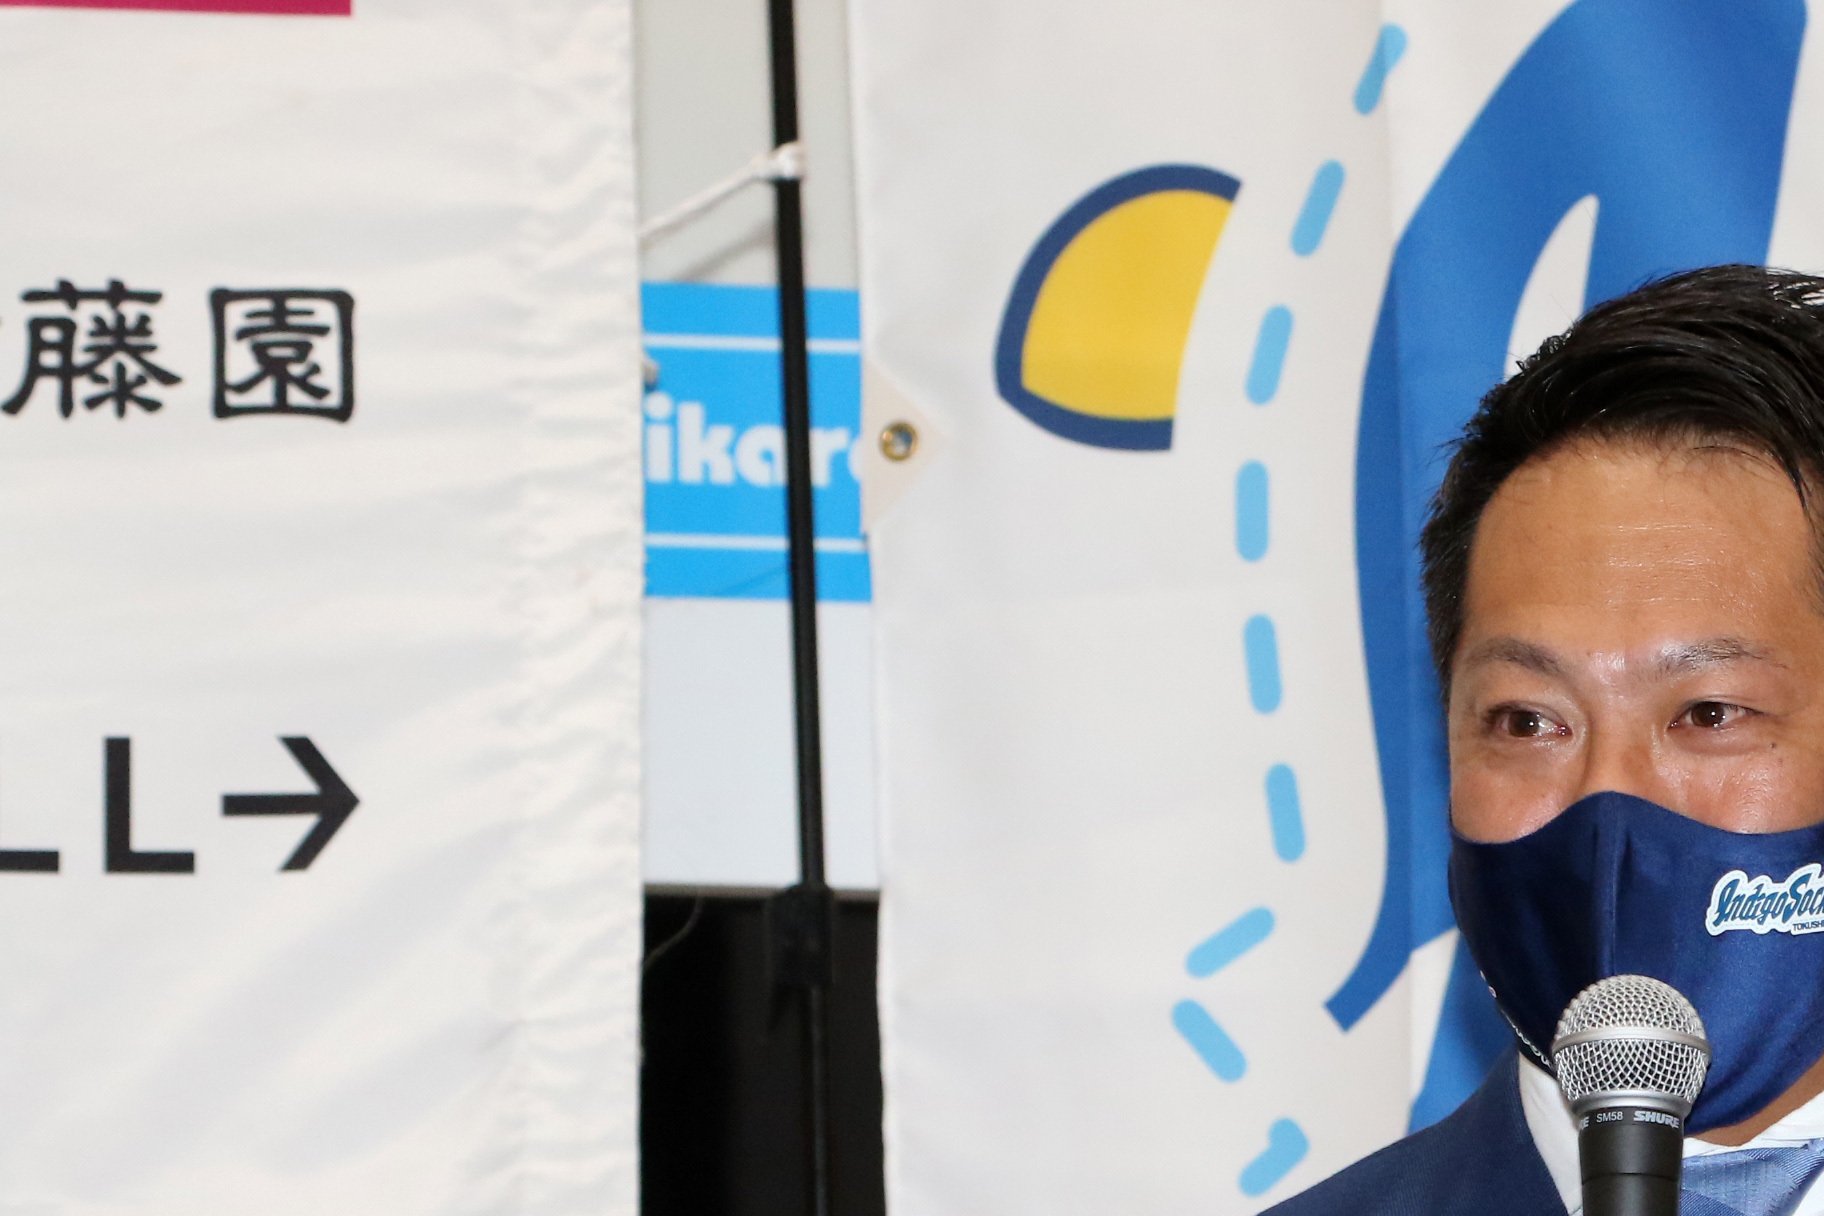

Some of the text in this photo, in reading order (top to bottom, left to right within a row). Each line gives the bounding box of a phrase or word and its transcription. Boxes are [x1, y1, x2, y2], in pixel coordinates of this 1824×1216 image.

[0, 279, 356, 422] 藤園
[644, 391, 862, 488] ikar
[1596, 1110, 1680, 1129] SM58 SHURE
